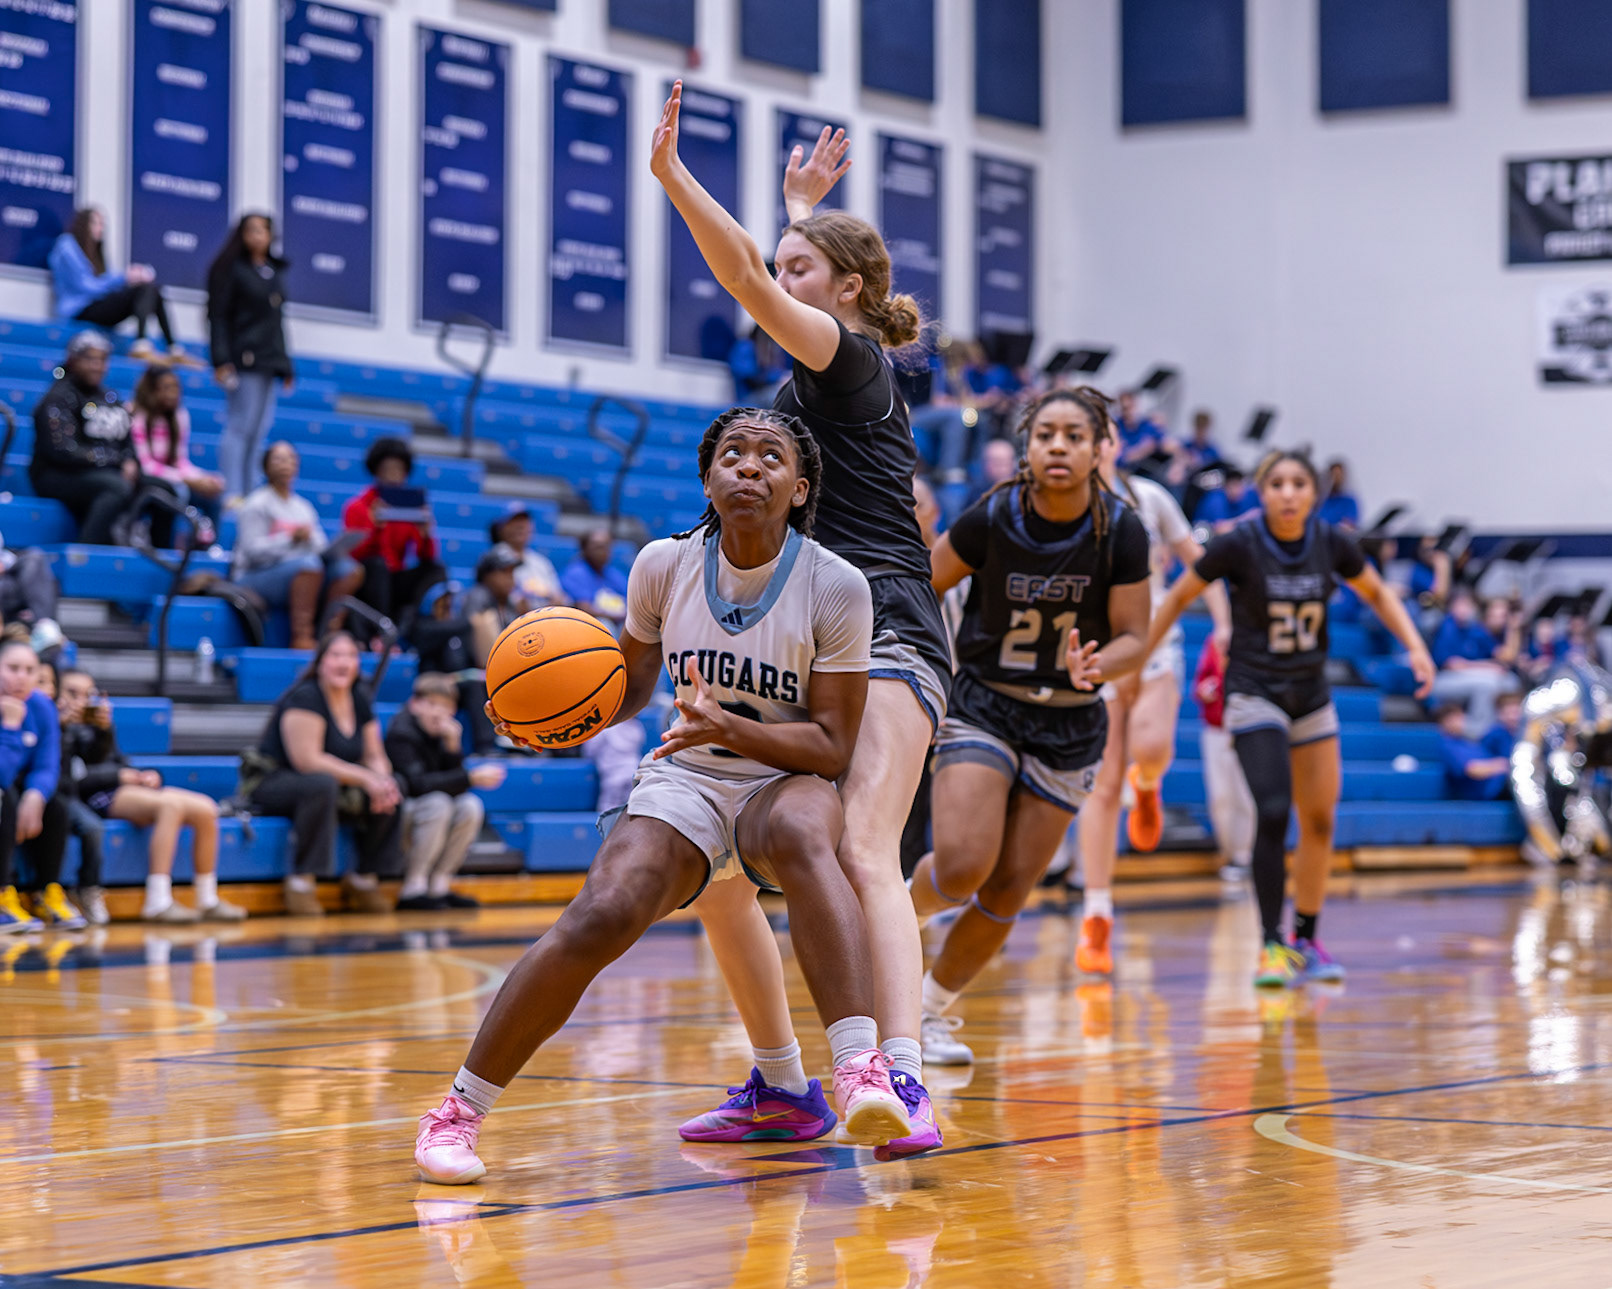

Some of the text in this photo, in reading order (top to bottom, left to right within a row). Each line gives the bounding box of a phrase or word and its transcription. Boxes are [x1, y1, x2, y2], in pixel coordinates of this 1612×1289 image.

[1006, 573, 1091, 603] EAST
[999, 608, 1078, 671] 21
[1268, 601, 1324, 653] 20
[668, 649, 798, 704] COUGARS
[535, 707, 603, 745] NCAA
